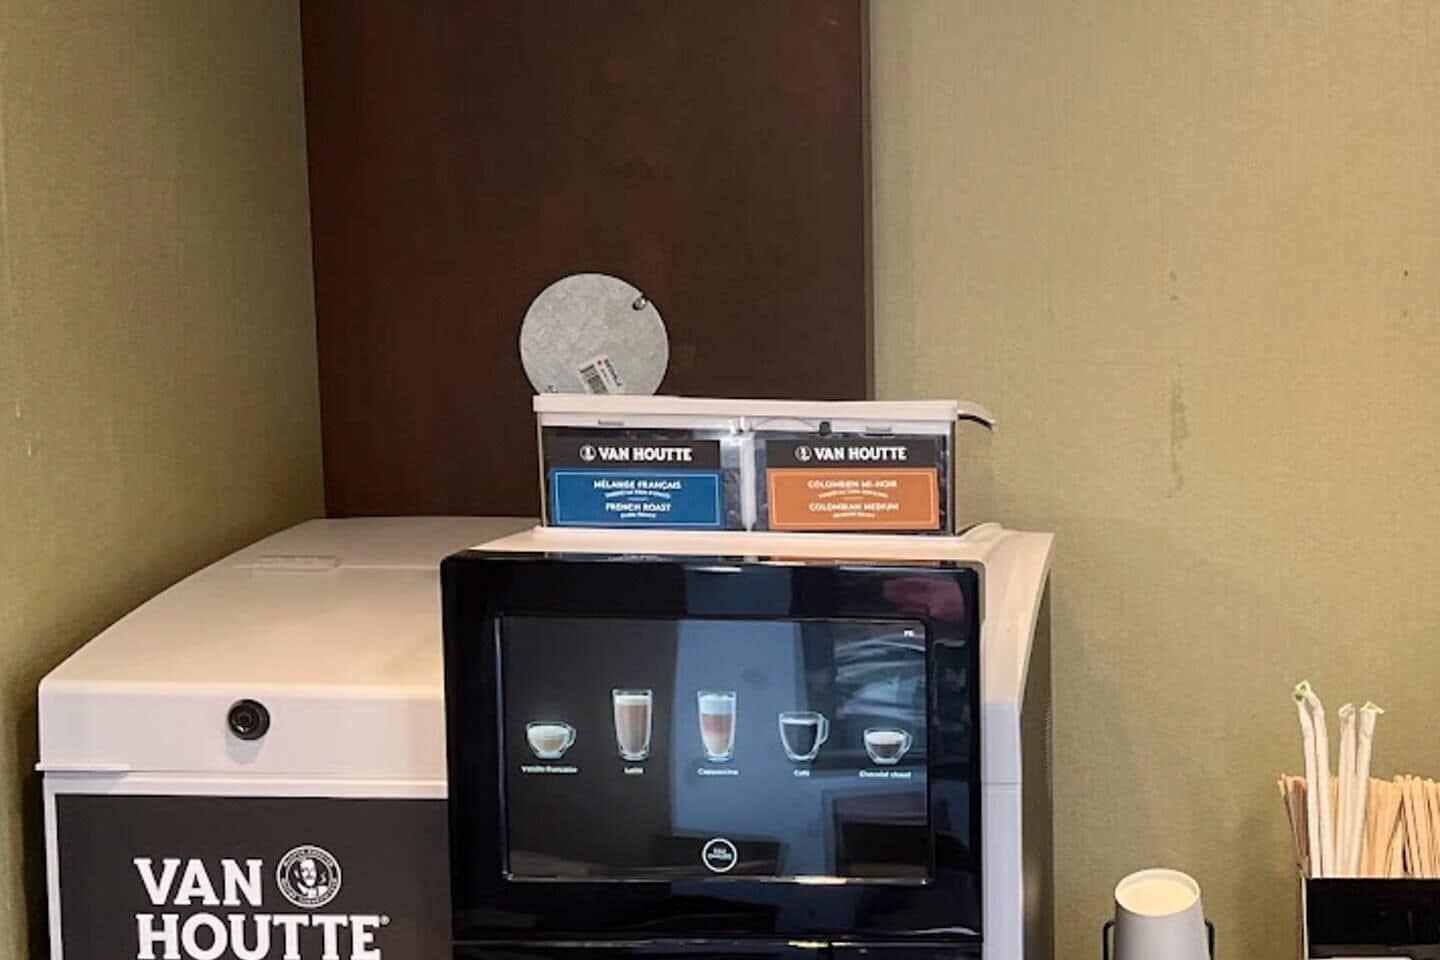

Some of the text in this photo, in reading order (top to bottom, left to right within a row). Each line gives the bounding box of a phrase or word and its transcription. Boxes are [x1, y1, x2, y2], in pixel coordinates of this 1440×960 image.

[598, 447, 693, 462] VAN HOUTTE
[814, 446, 907, 461] VAN HOUTTE
[643, 503, 672, 512] ROAST
[133, 858, 263, 906] VAN
